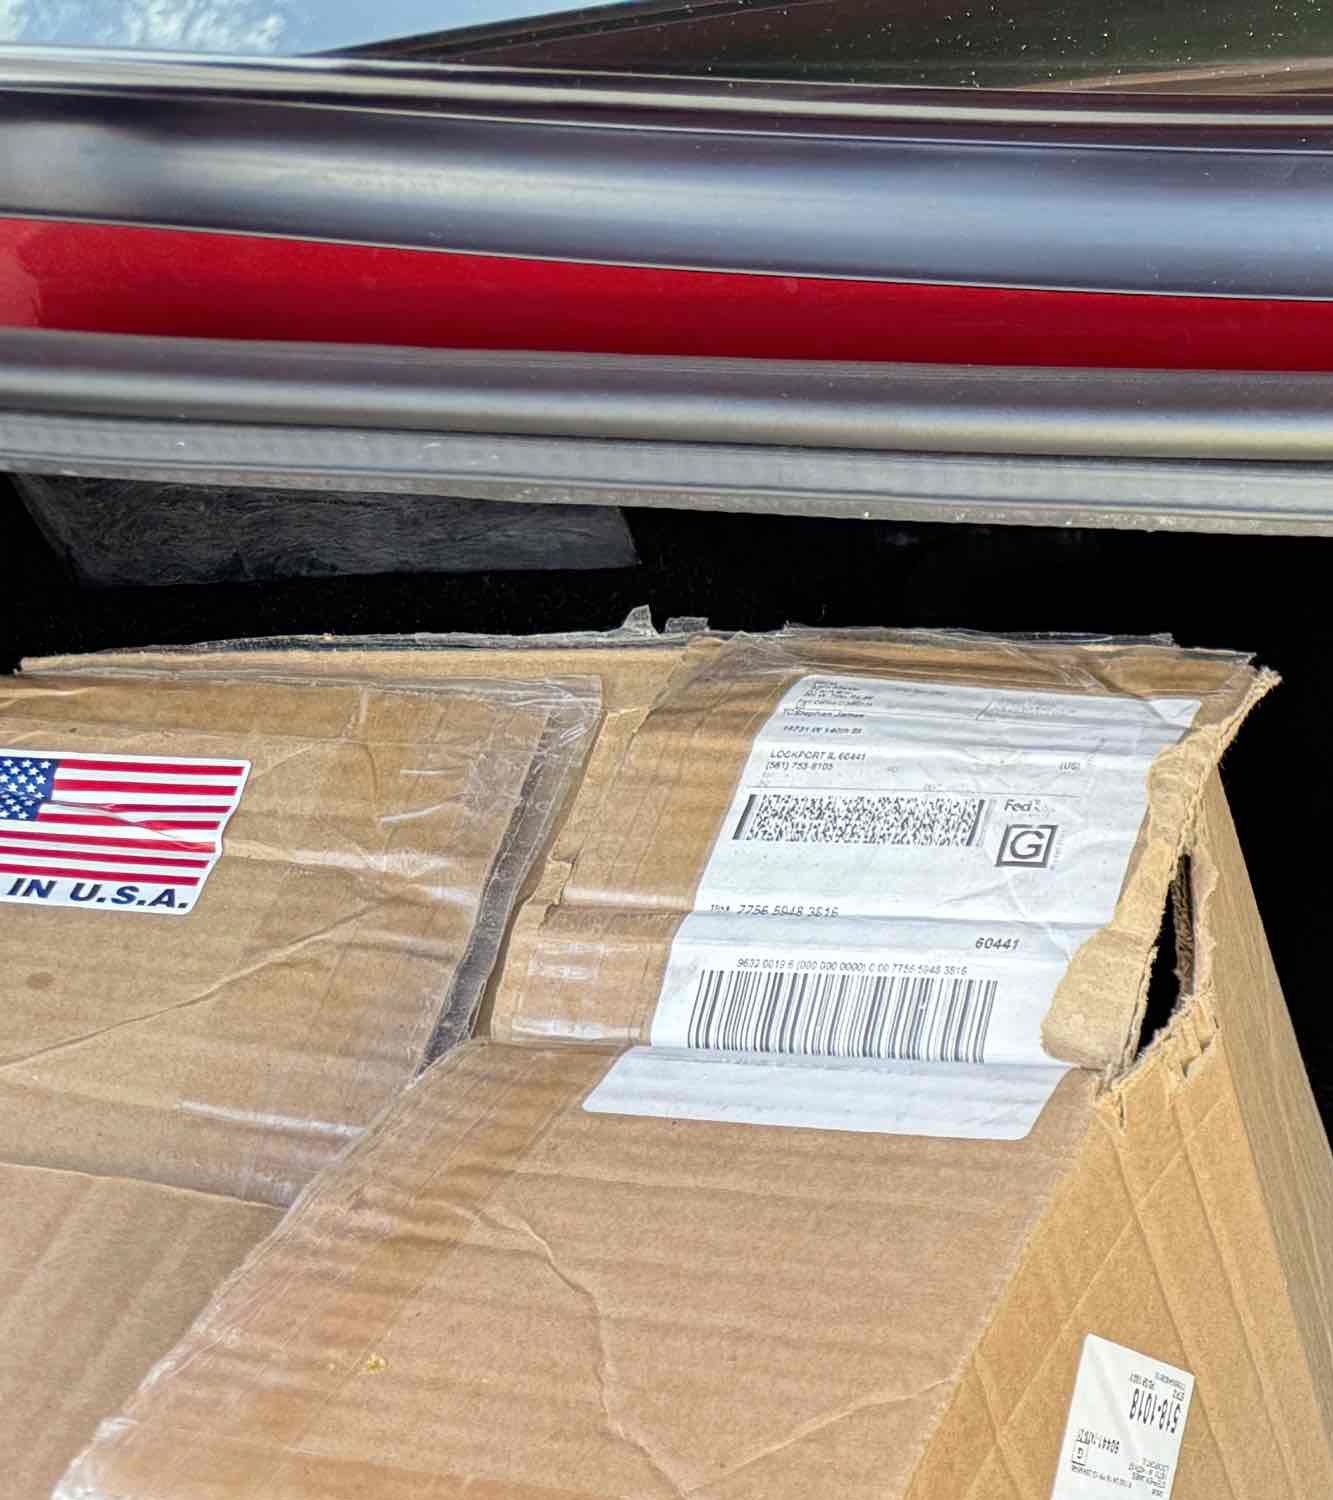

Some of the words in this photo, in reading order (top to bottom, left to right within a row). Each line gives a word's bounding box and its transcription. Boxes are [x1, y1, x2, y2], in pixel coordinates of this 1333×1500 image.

[7, 877, 57, 899] IN
[69, 882, 189, 909] U.S.A.
[975, 936, 1020, 950] 60441
